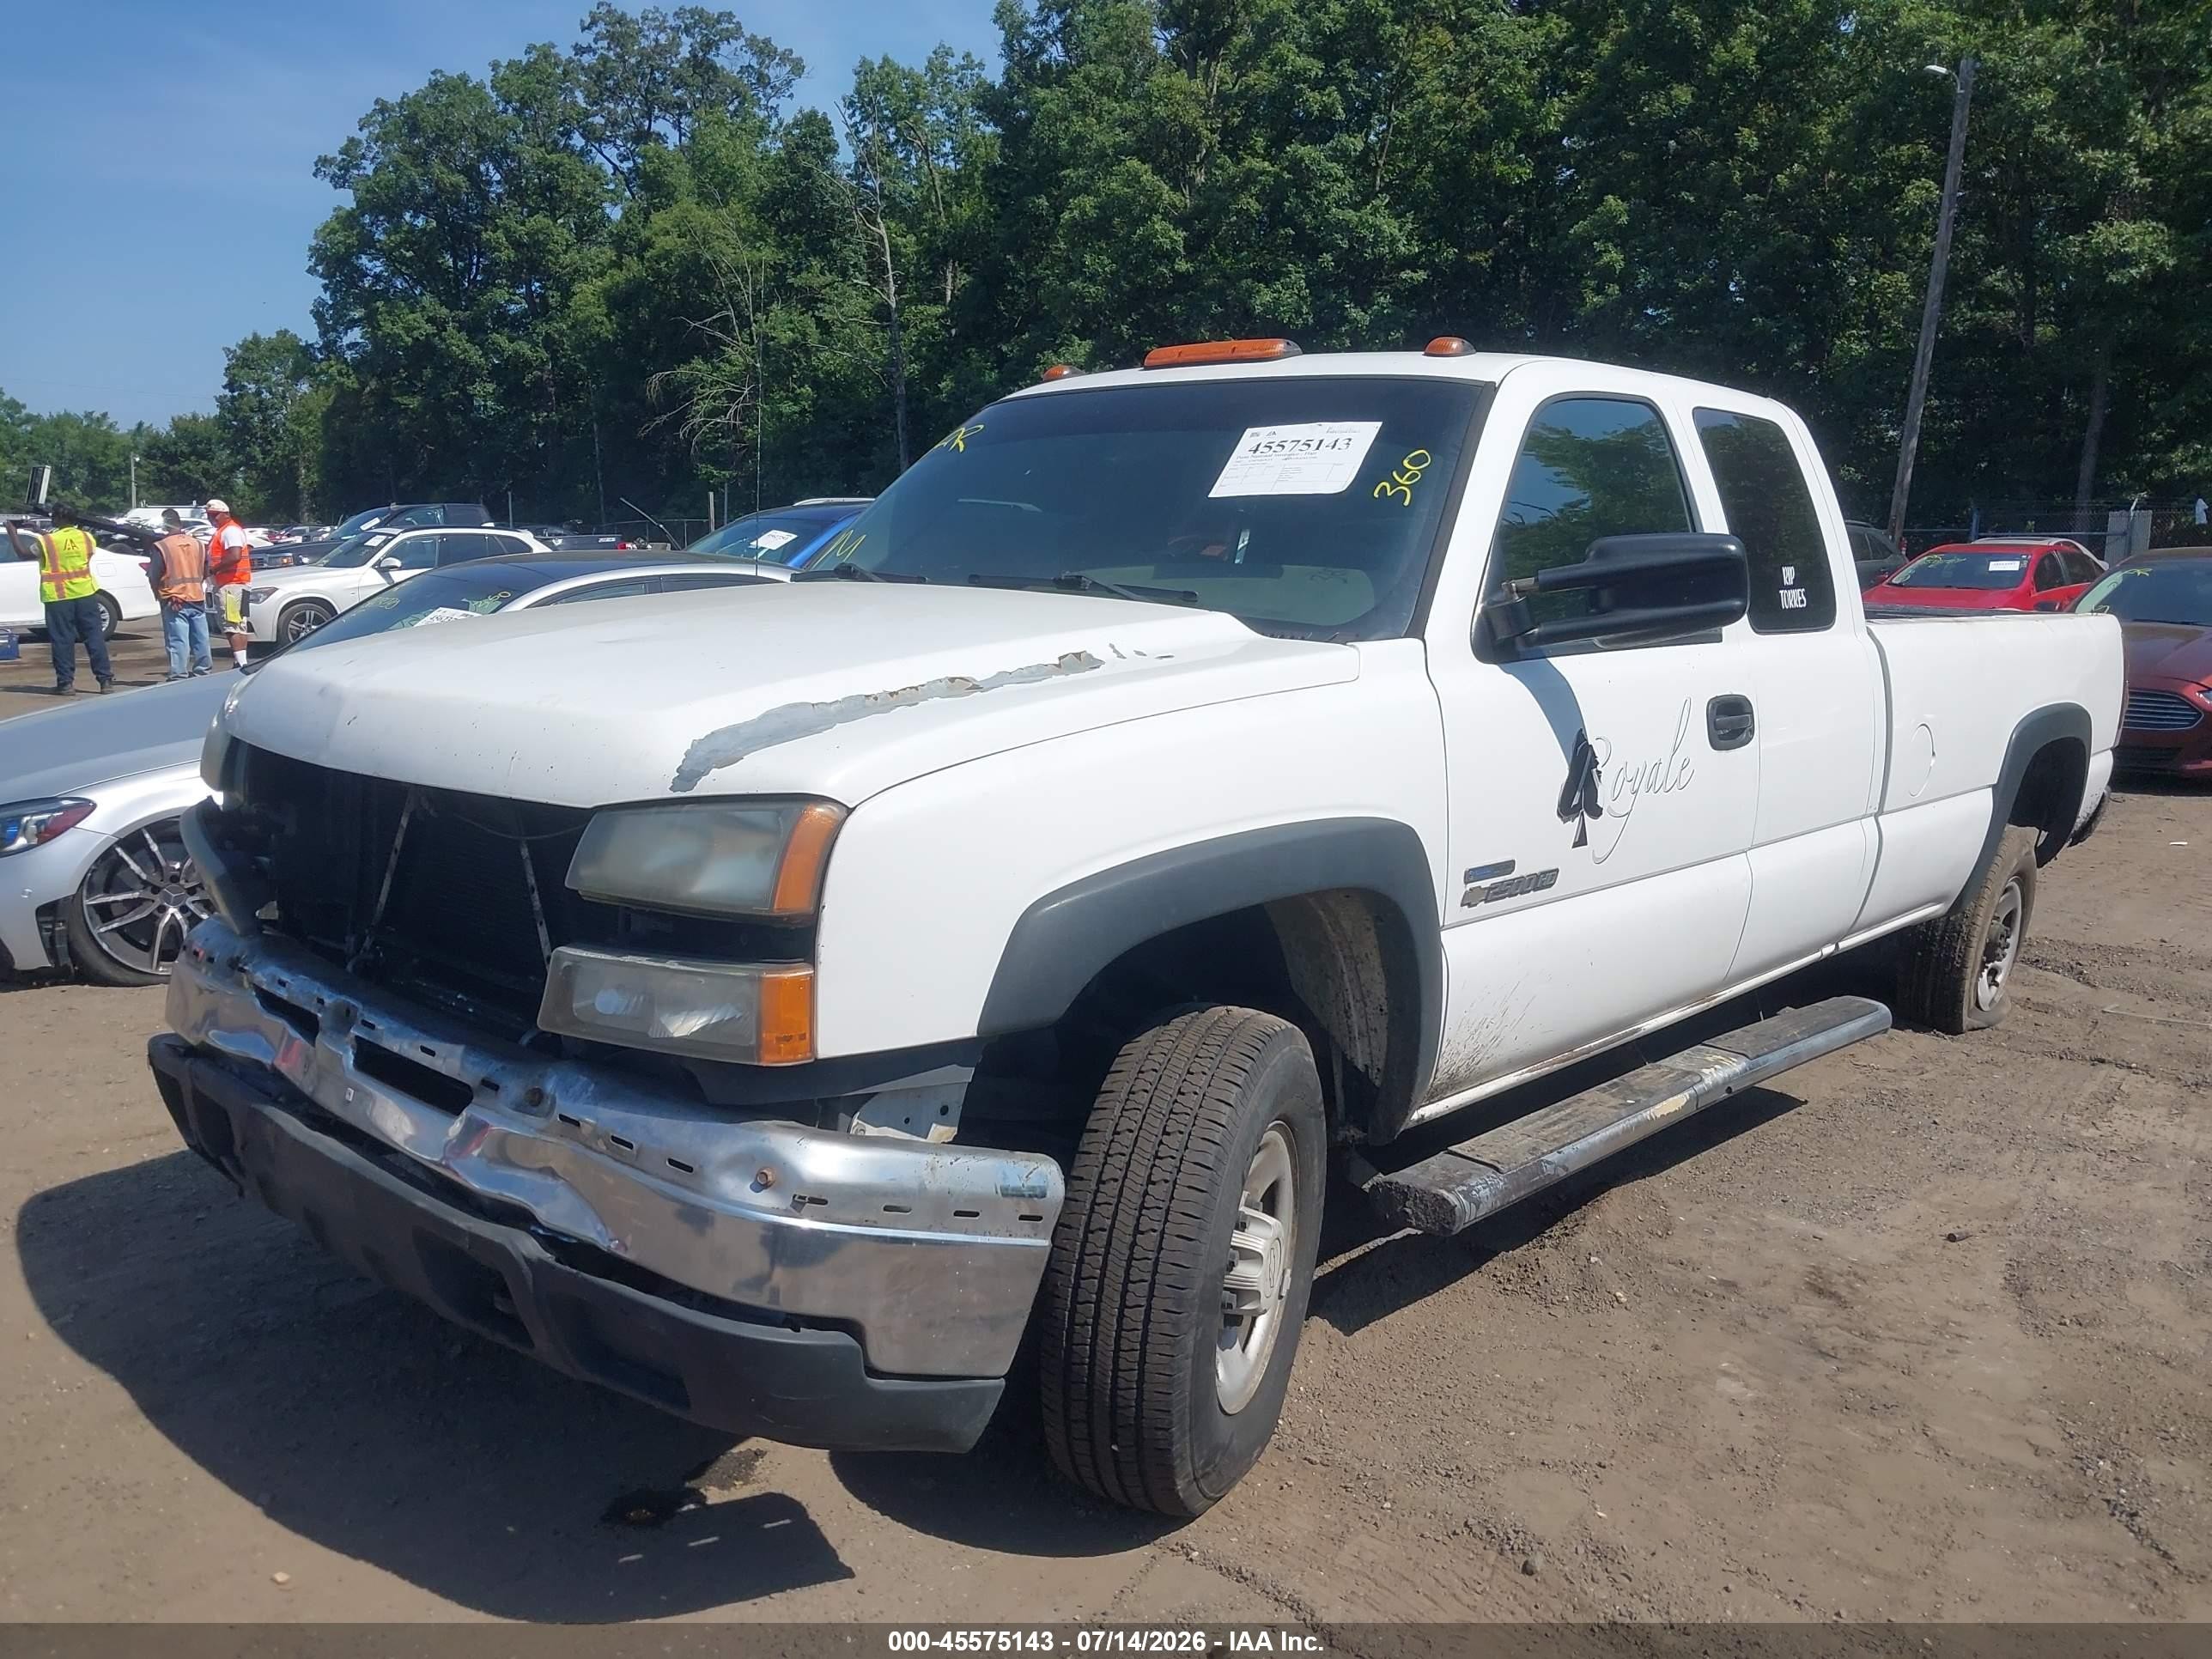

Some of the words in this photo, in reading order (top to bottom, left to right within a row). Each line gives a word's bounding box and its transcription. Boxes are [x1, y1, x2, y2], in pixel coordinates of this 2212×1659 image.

[1248, 437, 1353, 454] 45575143
[1373, 449, 1431, 507] 360
[1782, 566, 1796, 586] RIP
[1778, 587, 1807, 610] TORRES
